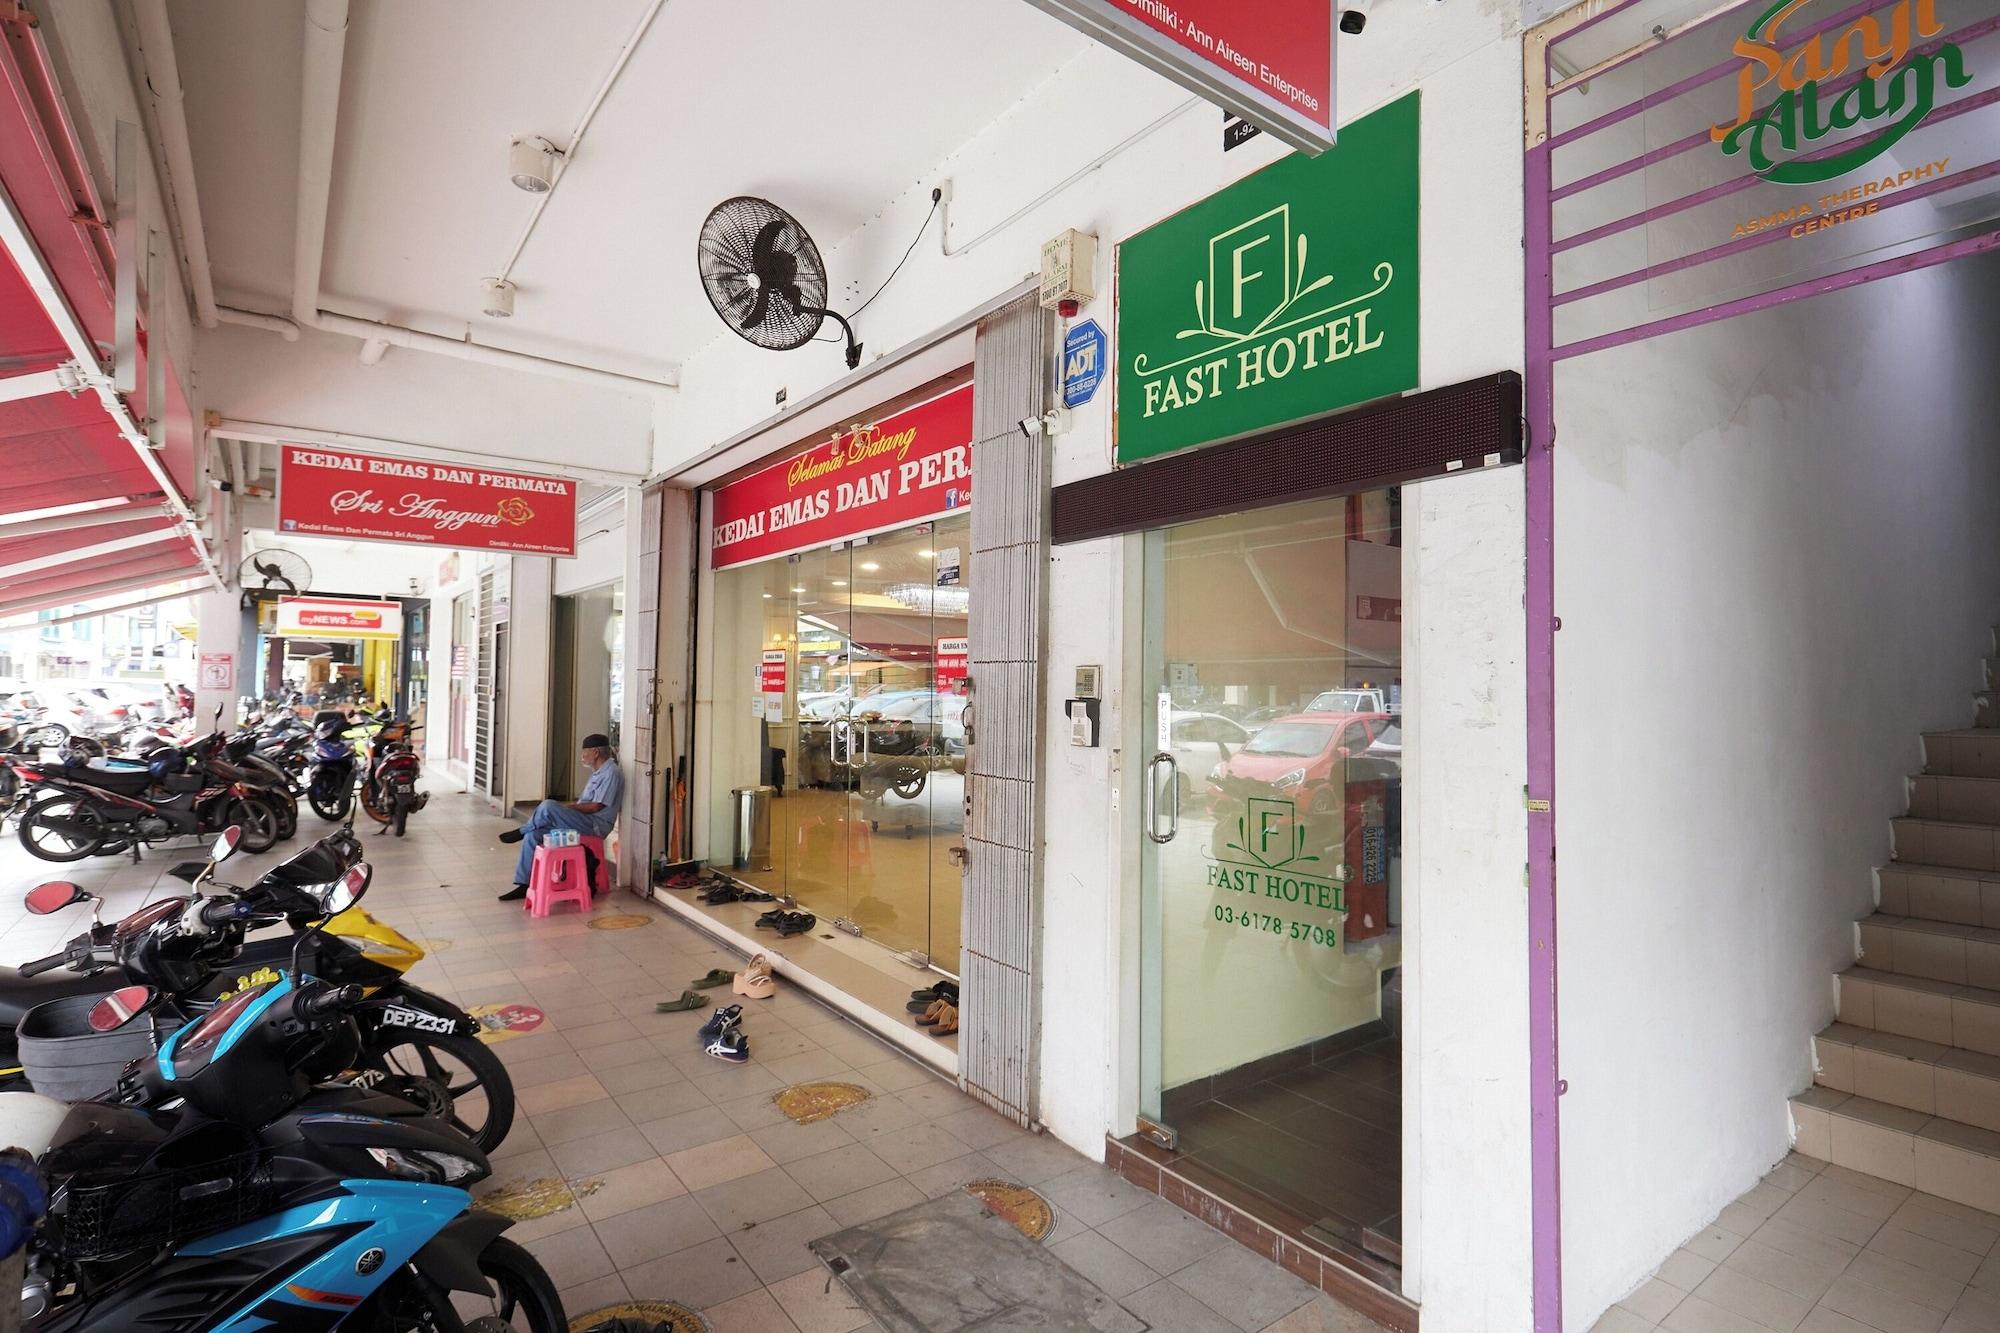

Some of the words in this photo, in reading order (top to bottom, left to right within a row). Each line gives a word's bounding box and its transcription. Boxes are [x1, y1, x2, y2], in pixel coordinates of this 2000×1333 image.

[1186, 20, 1213, 51] Ann
[1216, 38, 1257, 76] Aireen
[1260, 66, 1318, 111] Enterprise
[1731, 203, 1812, 239] ASMMA
[1817, 157, 1950, 209] THERAPHY
[1790, 202, 1881, 239] CENTRE
[1233, 234, 1270, 319] F
[1067, 333, 1088, 348] Secured
[1088, 331, 1096, 340] by
[1065, 343, 1097, 381] ADT
[1143, 358, 1228, 418] FAST
[1236, 308, 1385, 389] HOTEL
[292, 451, 363, 472] KEDAI
[368, 460, 428, 479] EMAS
[433, 468, 473, 485] DAN
[478, 474, 568, 496] PERMATA
[787, 454, 845, 491] Selamat
[847, 425, 917, 465] Datang
[330, 490, 384, 515] Sri
[388, 493, 502, 530] Anggun
[713, 511, 765, 549] KEDAI
[768, 488, 830, 533] EMAS
[835, 468, 892, 513] DAN
[897, 440, 972, 496] PER
[298, 522, 321, 531] Kedai
[322, 524, 344, 533] Emas
[345, 526, 362, 534] Dan
[363, 528, 394, 537] Permata
[406, 532, 435, 541] Anggun
[1262, 811, 1284, 853] F
[1206, 864, 1260, 894] FAST
[1265, 875, 1349, 912] HOTEL
[1214, 904, 1282, 935] 03-6178
[1290, 922, 1336, 948] 5708
[383, 1009, 416, 1026] DEP
[414, 1014, 457, 1035] 2331
